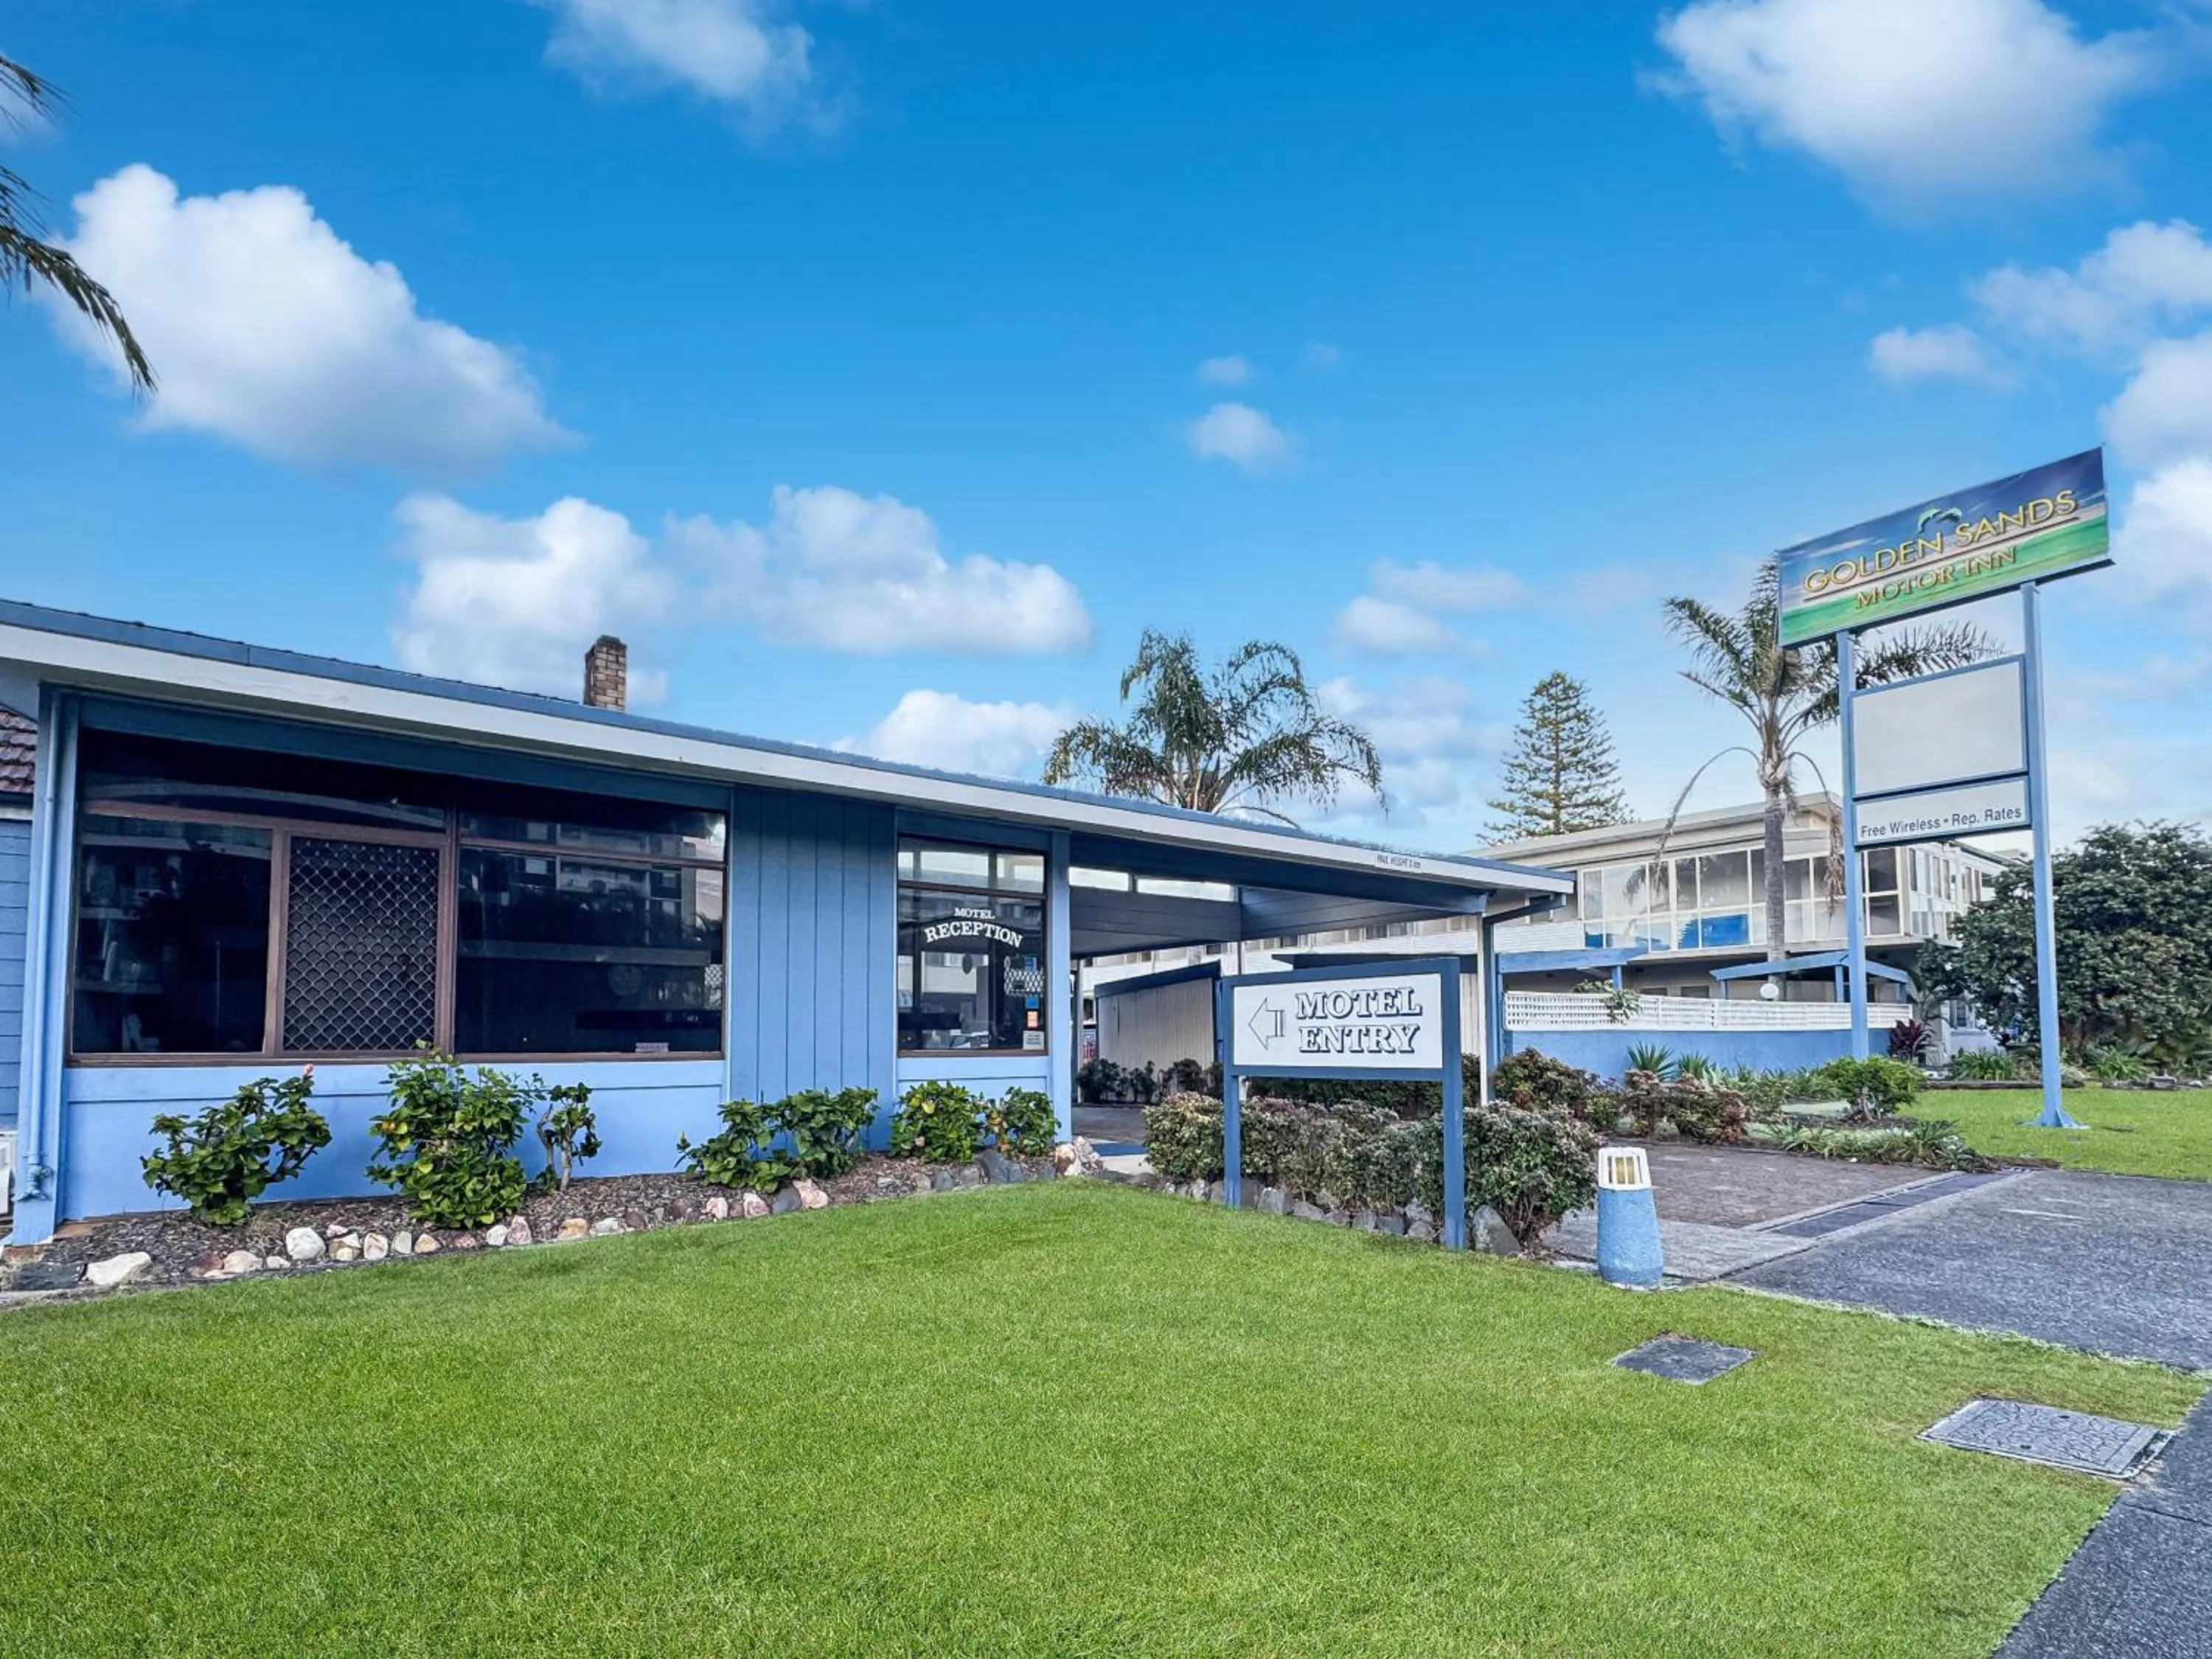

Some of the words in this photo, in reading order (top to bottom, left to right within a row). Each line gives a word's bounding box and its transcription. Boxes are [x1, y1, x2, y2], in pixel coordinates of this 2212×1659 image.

[1803, 531, 1944, 593] GOLDEN
[1955, 488, 2079, 548] SANDS
[1856, 566, 1955, 609] MOTOR
[1966, 544, 2018, 577] INN
[1860, 824, 1886, 838] Free
[1889, 816, 1941, 835] Wireless
[1952, 813, 1980, 827] Rep.
[1984, 807, 2022, 822] Rates
[954, 908, 995, 919] MOTEL
[925, 922, 1023, 947] RECEPTION
[1295, 987, 1423, 1020] MOTEL
[1298, 1023, 1421, 1054] ENTRY
